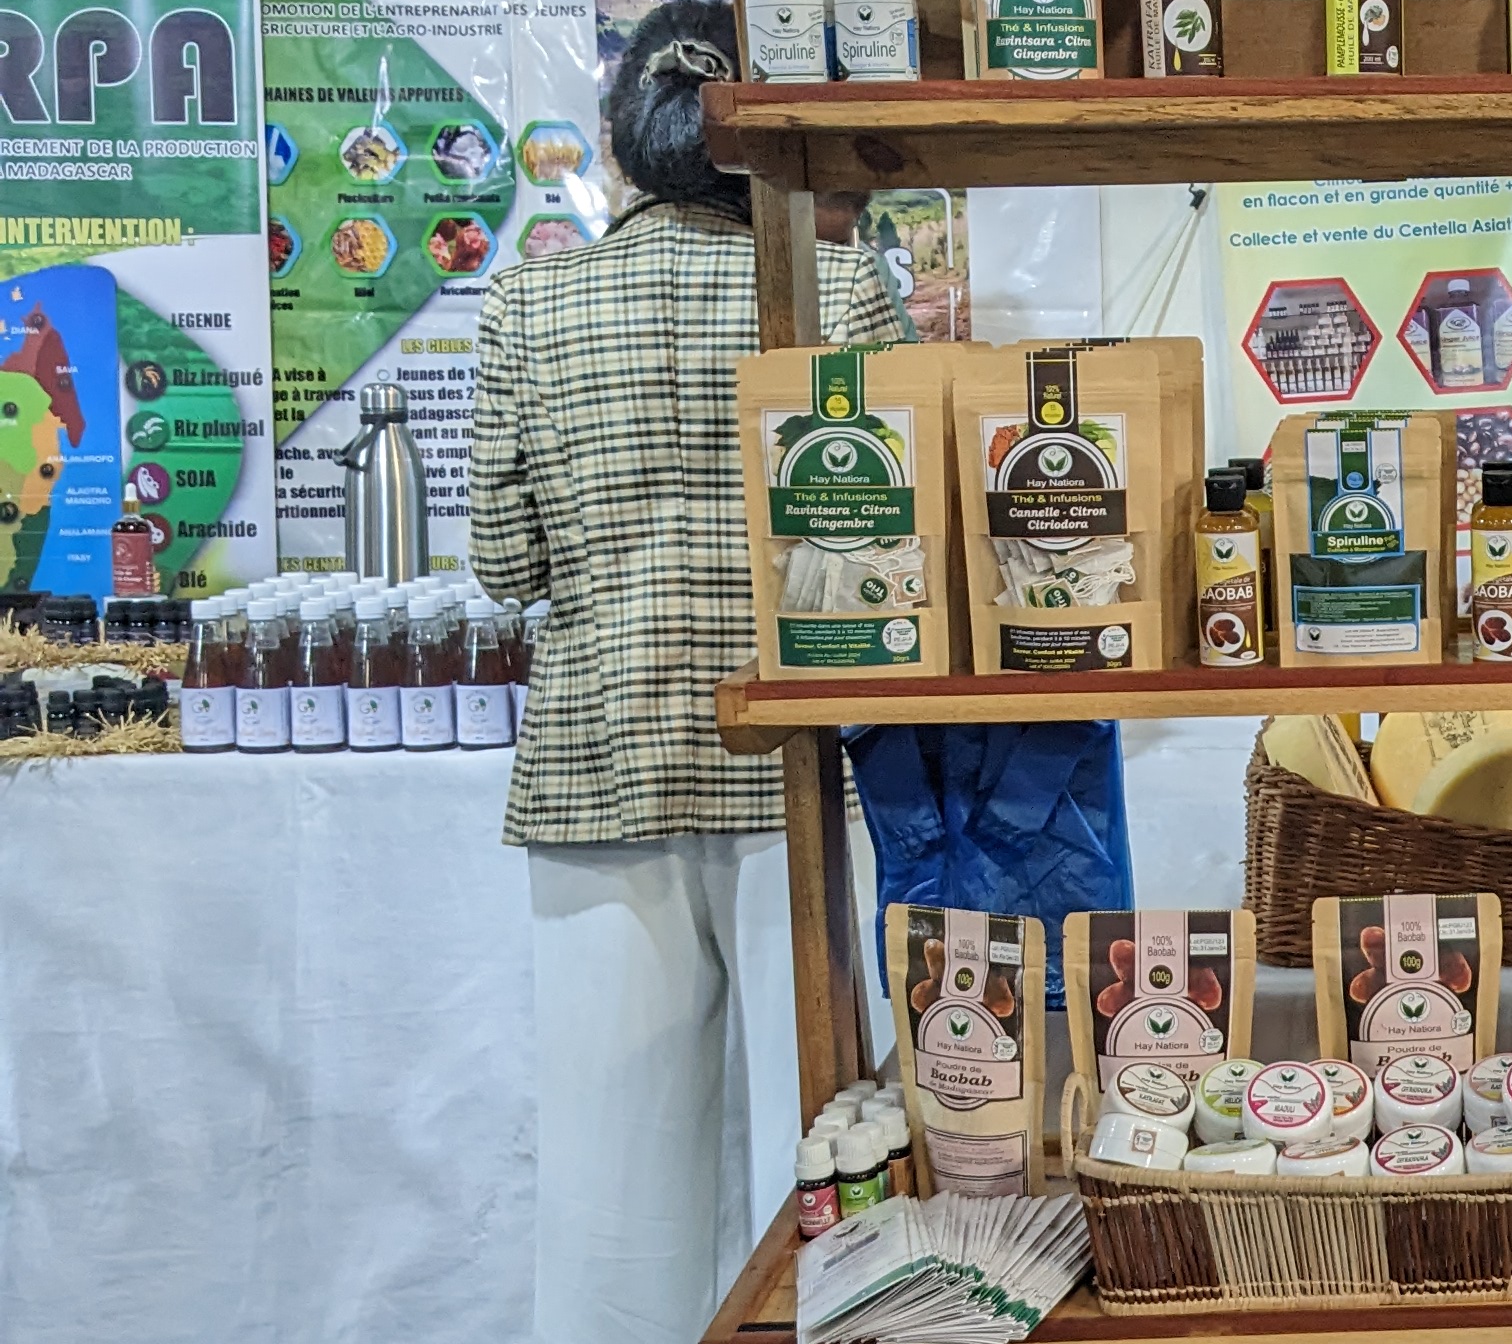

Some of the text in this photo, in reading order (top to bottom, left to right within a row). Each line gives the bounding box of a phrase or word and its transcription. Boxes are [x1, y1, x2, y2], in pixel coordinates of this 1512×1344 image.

[341, 5, 358, 17] DE
[503, 5, 528, 16] DES
[353, 23, 370, 35] ET
[760, 43, 816, 63] Spiruline
[842, 40, 897, 61] Spiruline
[1014, 48, 1078, 61] Gingembre
[318, 88, 334, 102] DE
[89, 140, 114, 156] DE
[117, 141, 140, 156] LA
[145, 140, 257, 157] PRODUCTION
[6, 163, 133, 180] MADAGASCAR
[1242, 195, 1263, 209] en
[1268, 191, 1319, 208] flacon
[1325, 189, 1340, 204] et
[1344, 189, 1365, 204] en
[1370, 183, 1429, 205] grande
[1434, 177, 1499, 201] quantité
[1229, 219, 1467, 247] Collecte et vente du Centella
[171, 313, 232, 328] LEGENDE
[173, 369, 197, 386] Riz
[284, 368, 314, 381] vise
[397, 367, 463, 381] Jeunes de
[304, 388, 355, 401] travers
[438, 387, 463, 400] des
[174, 419, 264, 440] Riz pluvial
[176, 470, 217, 487] SOJA
[810, 473, 870, 485] Hay Natiora
[1026, 476, 1085, 488] Hay Natiora
[794, 491, 888, 502] Thé Infusions
[1011, 493, 1102, 504] Thé Infusions
[785, 503, 901, 516] Ravintsara Citron
[1008, 505, 1107, 518] Cannelle Citron
[178, 521, 257, 538] Arachide
[809, 517, 875, 531] Gingembre
[1027, 518, 1089, 530] Citriodora
[1327, 535, 1384, 549] Spiruline
[1402, 954, 1421, 969] 100g
[1151, 971, 1171, 985] 100g
[1408, 1023, 1442, 1033] Natiora
[1155, 1041, 1189, 1050] Natiora
[1387, 1044, 1420, 1054] Poudre
[930, 1068, 993, 1087] Baobab
